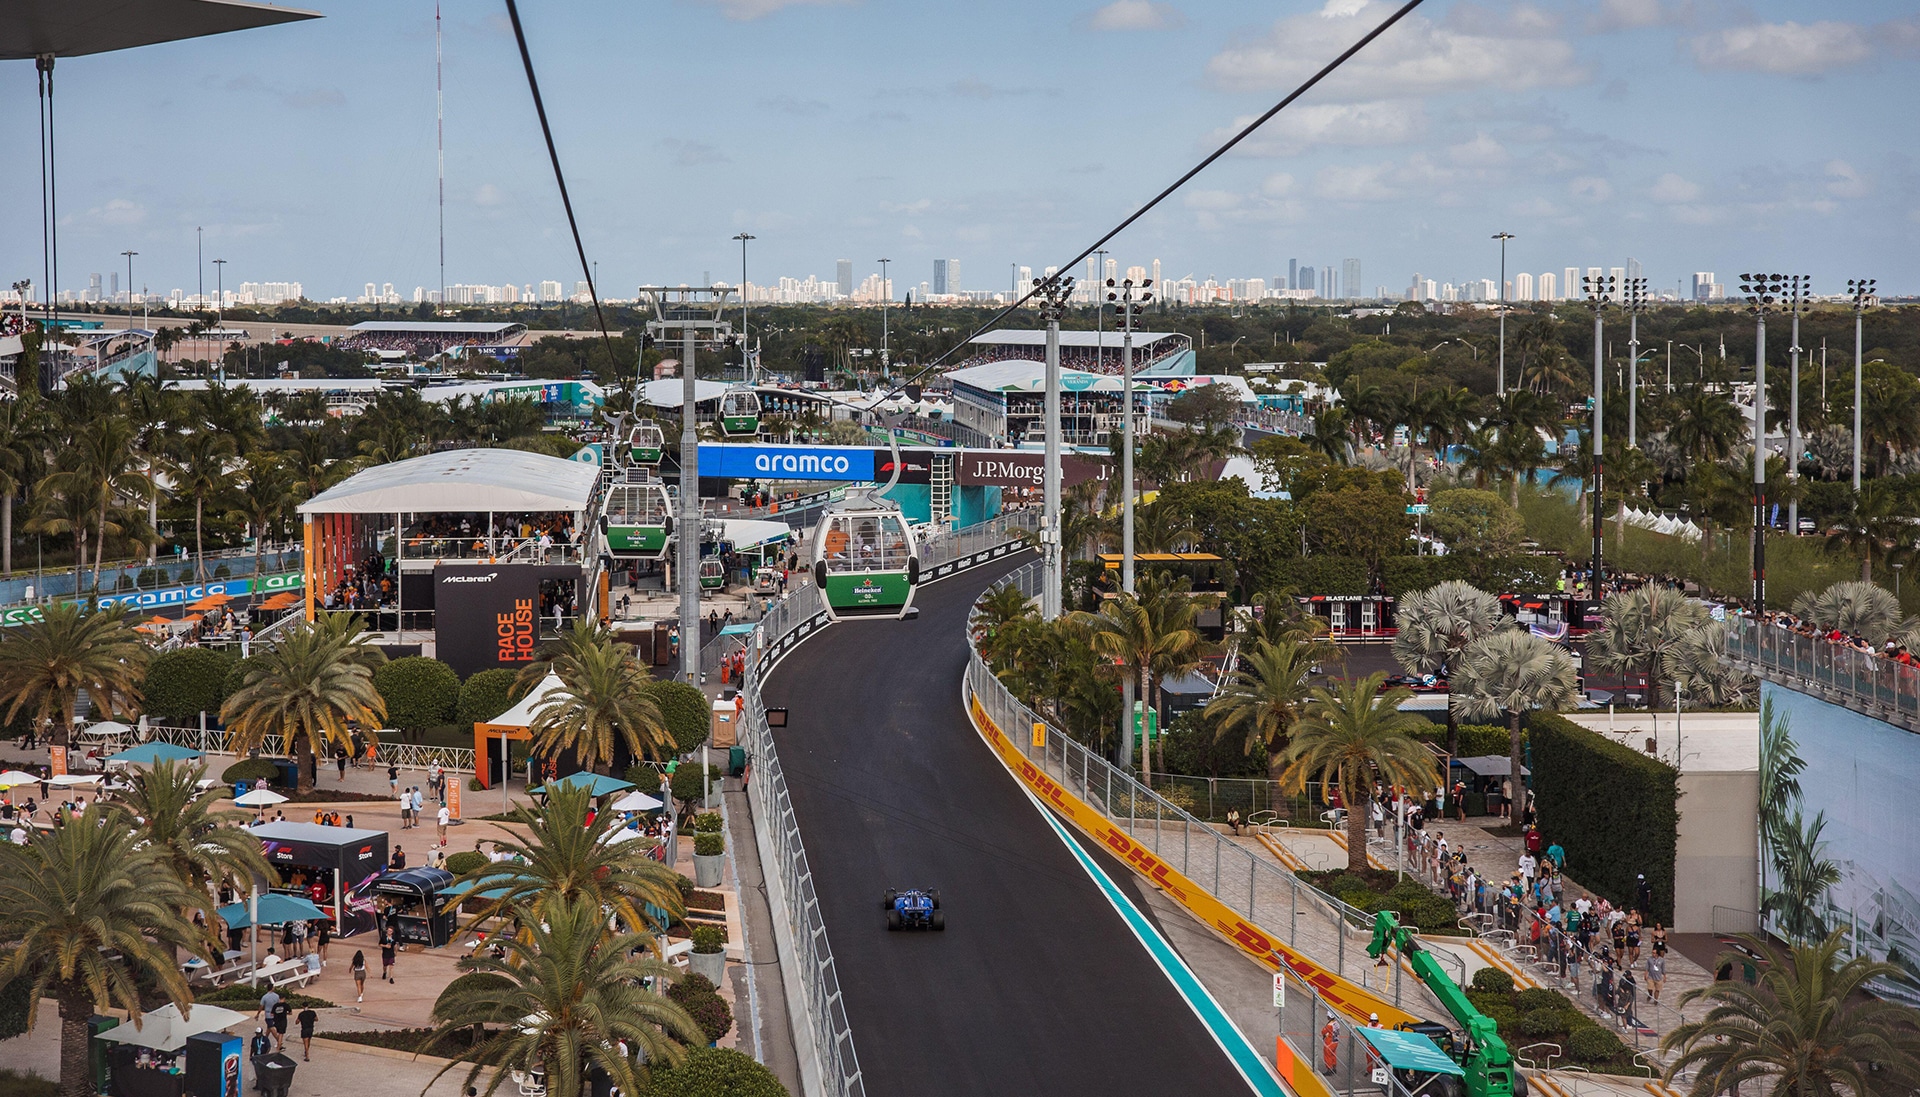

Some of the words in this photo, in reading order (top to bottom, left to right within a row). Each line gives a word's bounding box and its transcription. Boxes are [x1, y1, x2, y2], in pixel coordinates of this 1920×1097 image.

[579, 387, 595, 409] 3
[755, 454, 850, 473] aramco
[442, 575, 492, 583] McLaren
[497, 613, 515, 662] RACE
[515, 598, 534, 661] HOUSE
[978, 709, 1001, 748] DHL
[1021, 760, 1065, 808] DHL
[276, 852, 293, 860] Store
[358, 851, 373, 861] Store
[1106, 828, 1174, 889] DHL
[1233, 921, 1345, 1004] DHL
